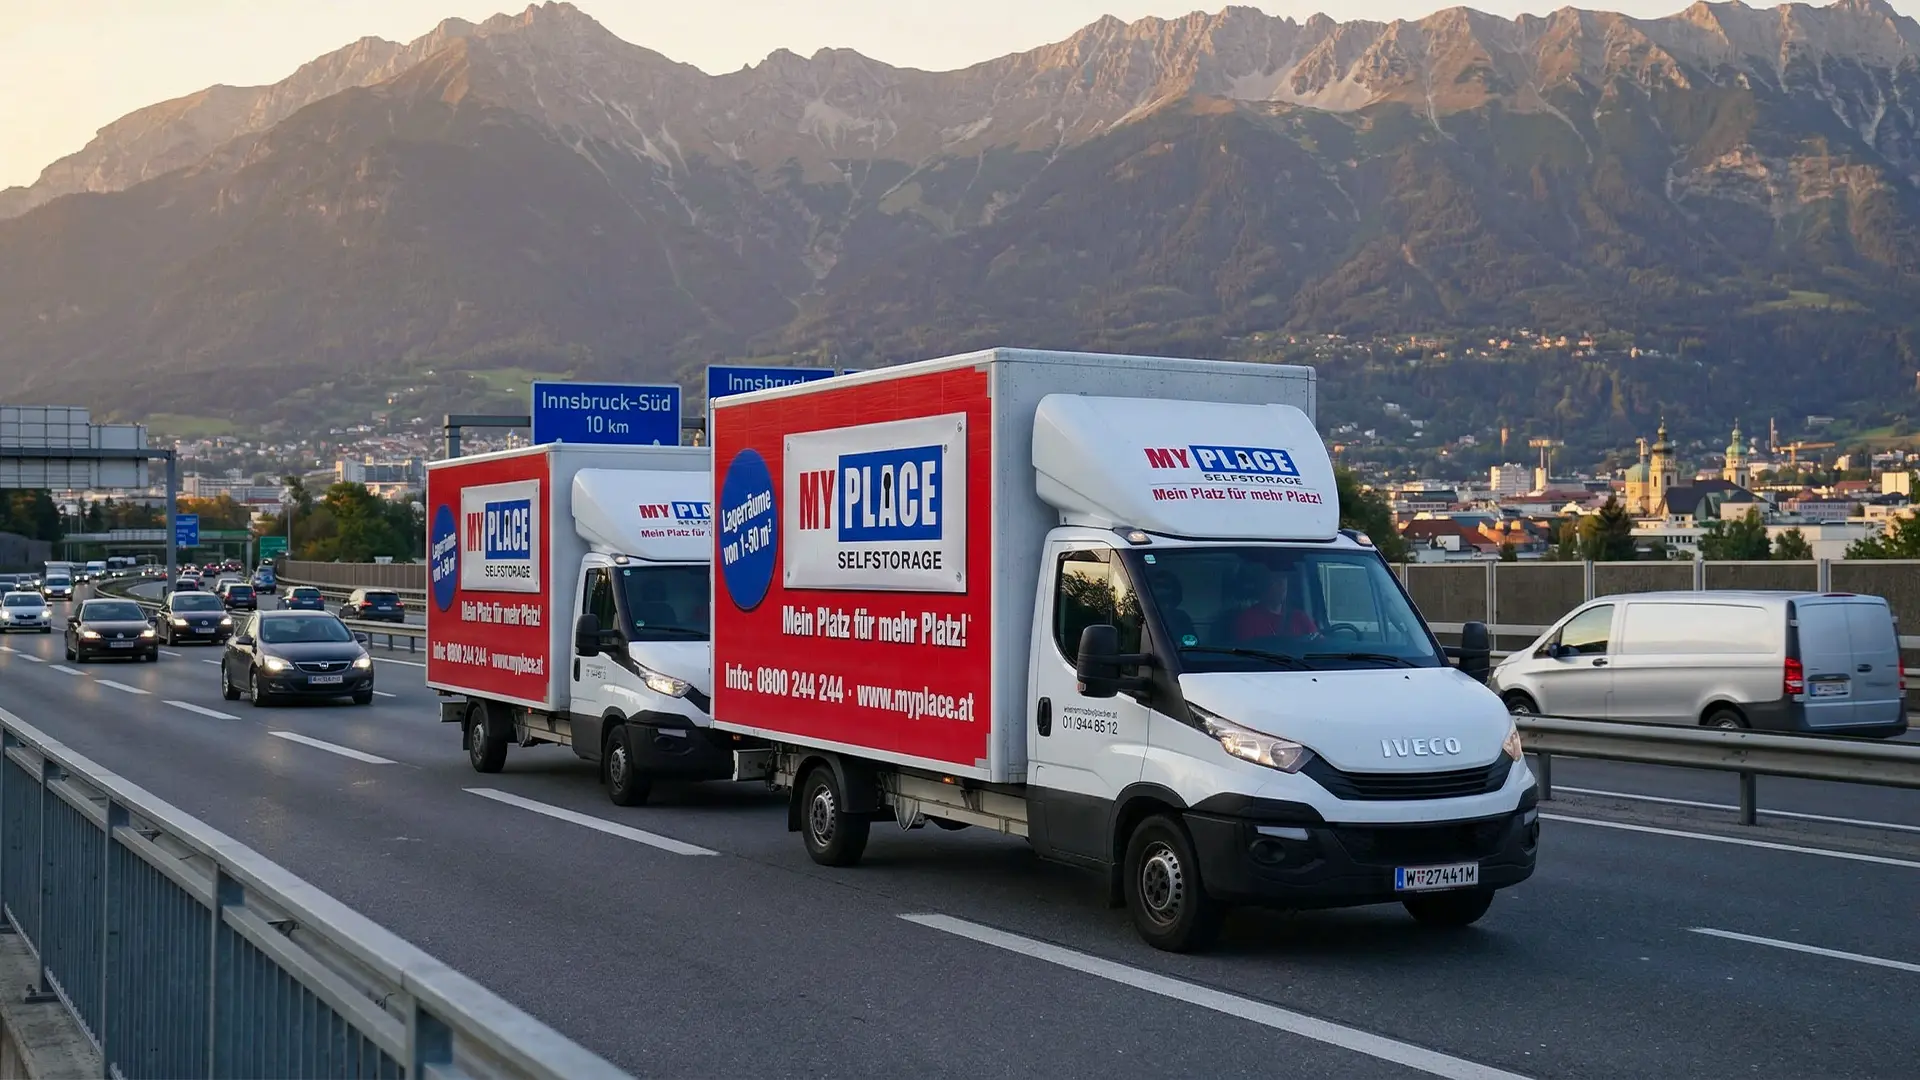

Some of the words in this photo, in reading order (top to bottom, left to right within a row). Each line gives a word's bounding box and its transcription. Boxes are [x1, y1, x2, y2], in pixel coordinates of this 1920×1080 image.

[728, 373, 811, 391] Innsbr
[542, 391, 671, 412] Innsbruck-Süd
[586, 415, 603, 433] 10
[608, 418, 629, 433] km
[1144, 448, 1190, 469] MY
[1196, 448, 1293, 473] PLACE
[1204, 474, 1303, 486] SELFSTORAGE
[799, 470, 836, 530] MY
[844, 460, 937, 529] PLACE
[1153, 488, 1188, 501] Mein
[1192, 487, 1225, 500] Platz
[1227, 488, 1247, 500] für
[1250, 490, 1283, 502] mehr
[1286, 490, 1323, 505] Platz!
[639, 504, 669, 519] MY
[722, 490, 772, 533] Lagerräume
[467, 512, 484, 551] MY
[487, 508, 528, 551] PLACE
[641, 529, 665, 538] Mein
[667, 528, 690, 537] Platz
[692, 528, 705, 537] für
[723, 541, 739, 566] von
[837, 550, 942, 570] SELFSTORAGE
[485, 565, 531, 578] SELFSTORAGE
[782, 605, 813, 636] Mein
[817, 606, 850, 639] Platz
[853, 607, 875, 640] für
[878, 610, 917, 644] mehr
[921, 611, 967, 648] Platz!
[463, 645, 474, 665] 244
[475, 647, 487, 667] 244
[725, 662, 753, 691] Info:
[756, 666, 788, 696] 0800
[791, 670, 815, 700] 244
[819, 673, 844, 704] 244
[857, 685, 975, 722] www.myplace.at
[1094, 719, 1106, 733] 85
[1107, 721, 1118, 735] 12
[1380, 737, 1461, 759] IVECO
